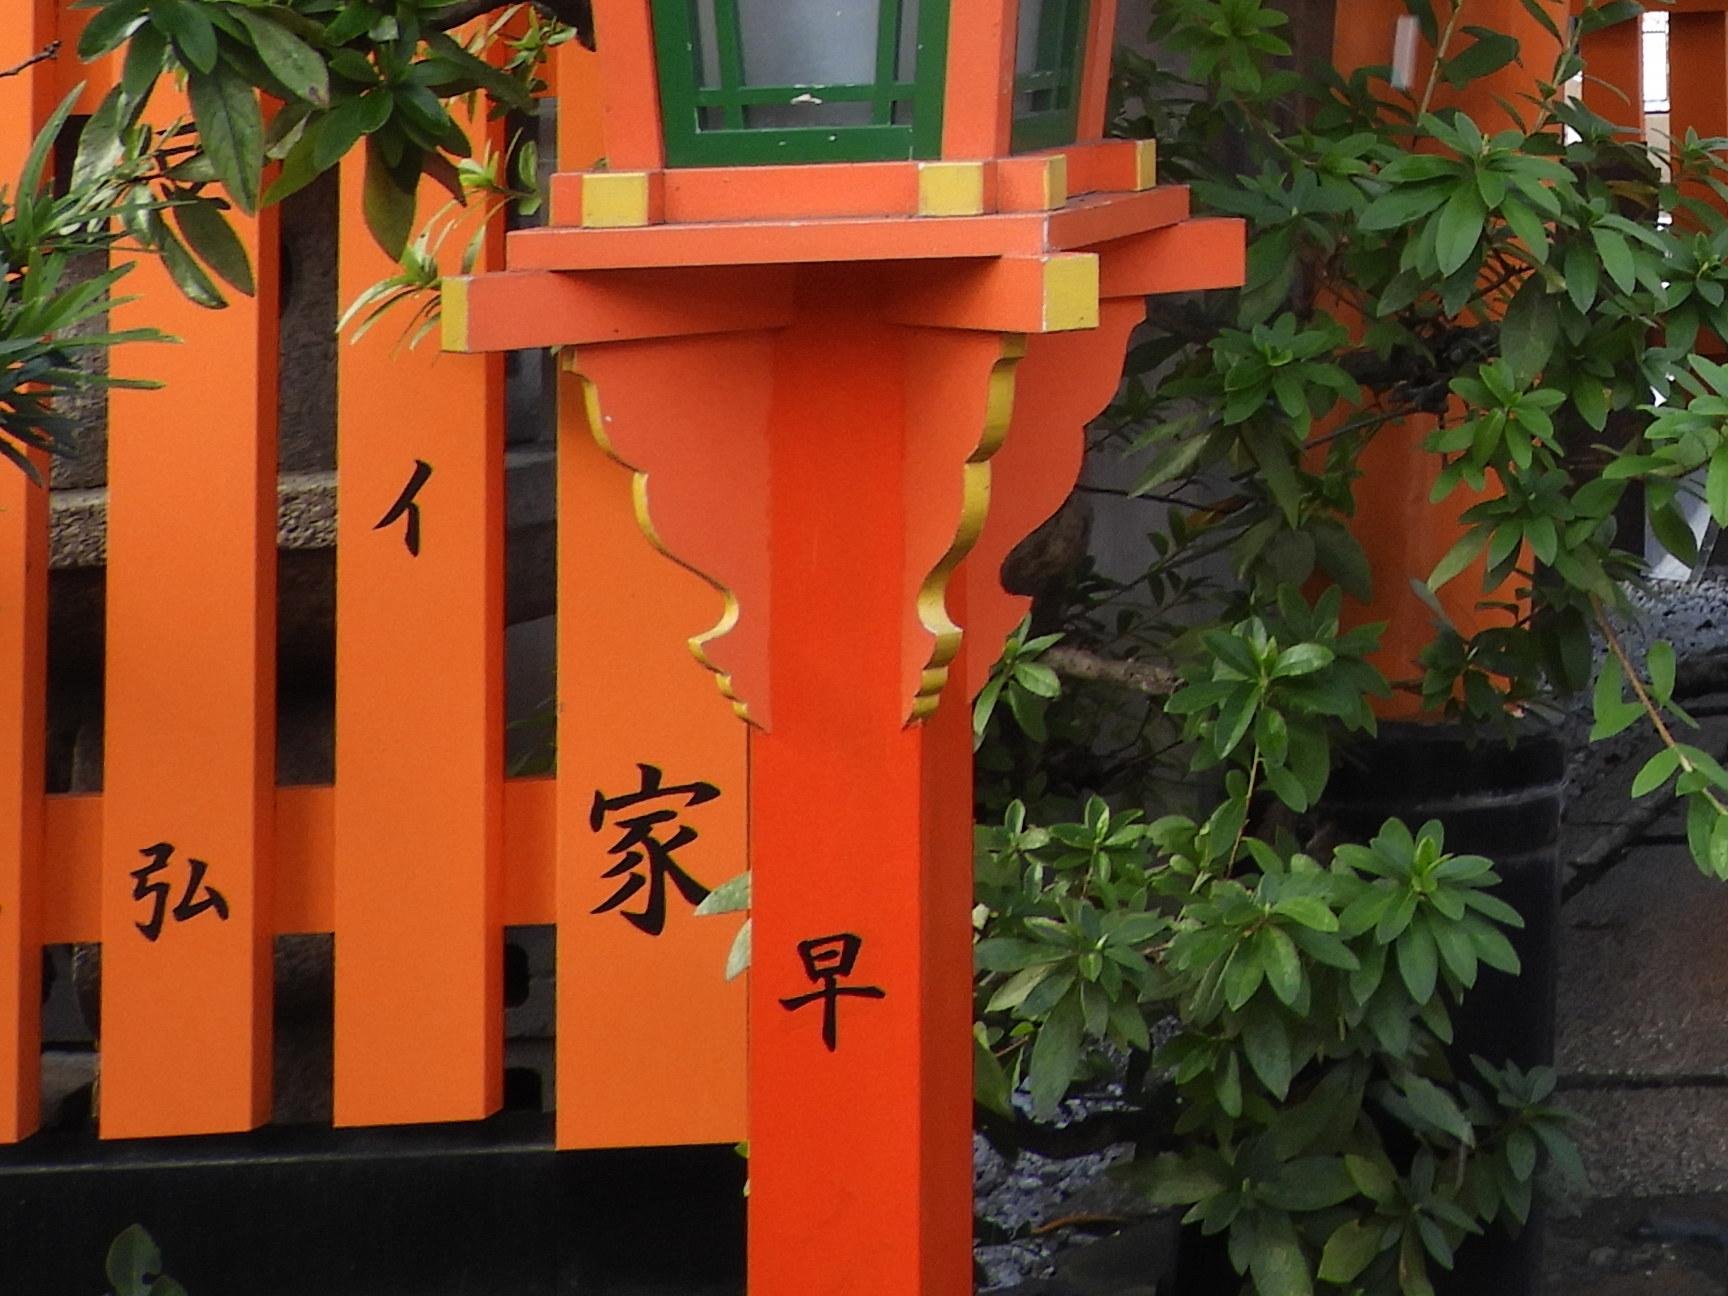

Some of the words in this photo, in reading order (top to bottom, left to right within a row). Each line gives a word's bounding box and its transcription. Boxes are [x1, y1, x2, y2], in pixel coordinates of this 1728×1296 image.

[130, 841, 231, 942] 弘
[587, 762, 721, 937] 家
[778, 931, 886, 1053] 早
